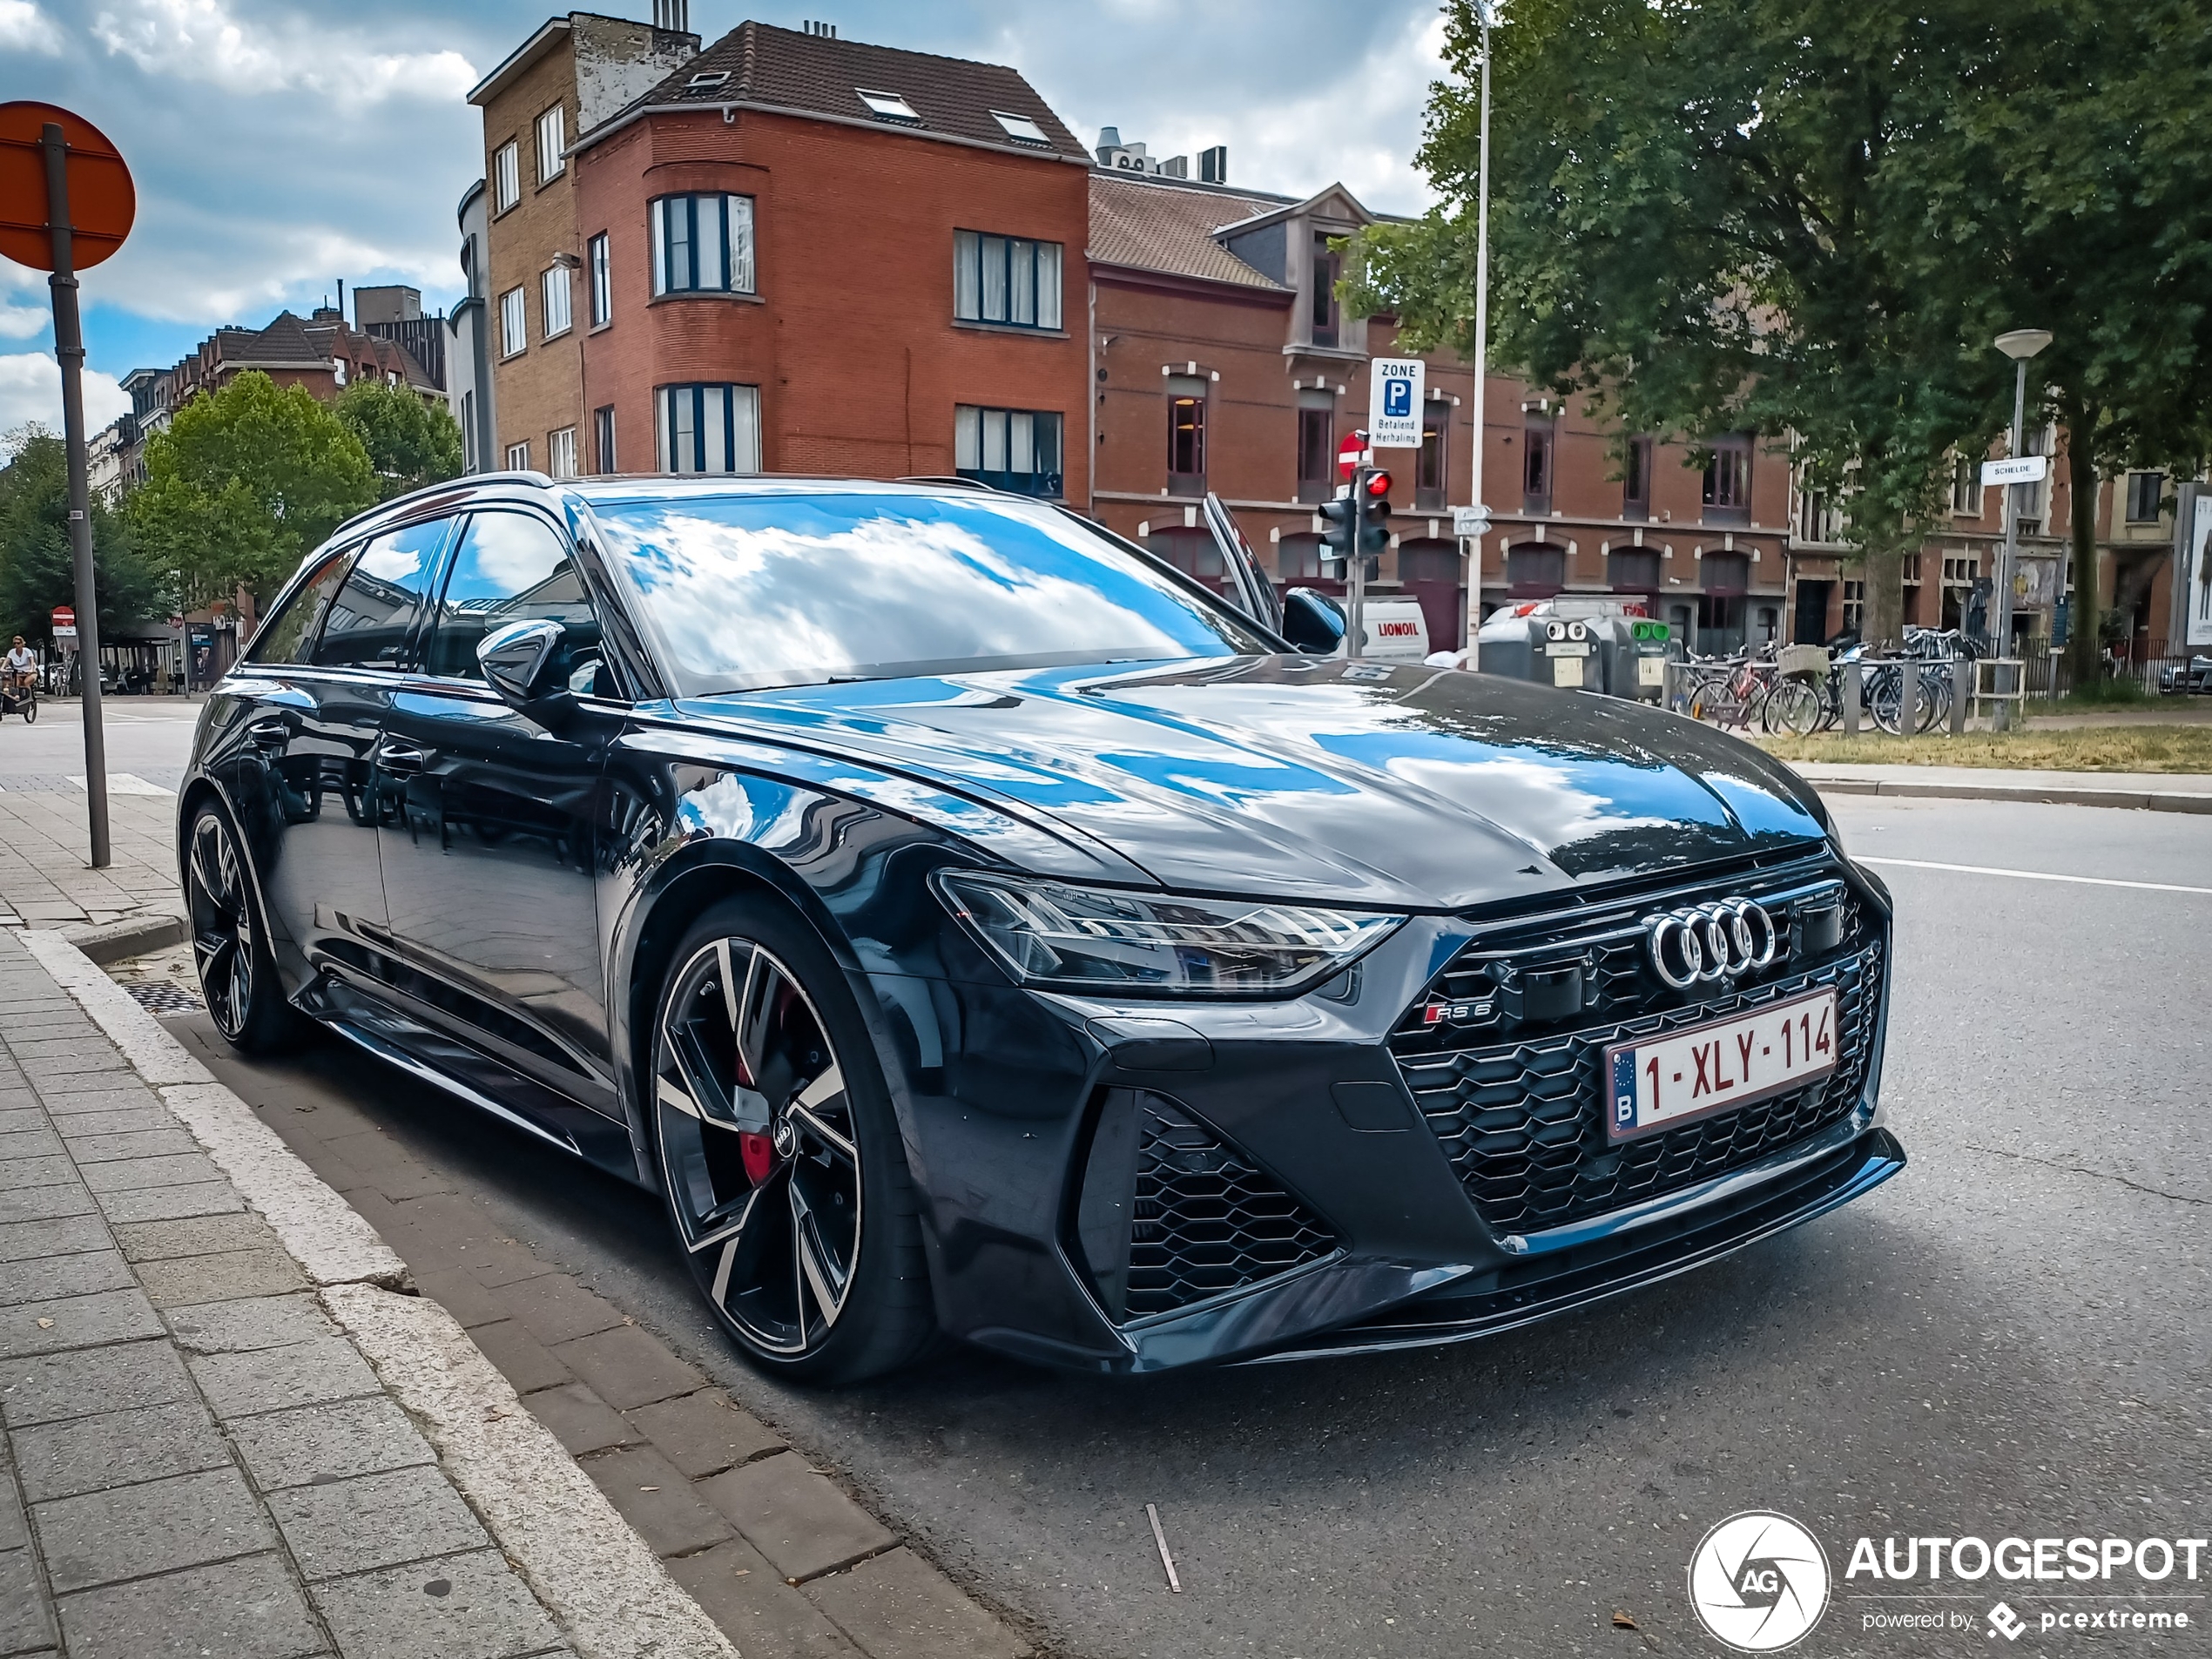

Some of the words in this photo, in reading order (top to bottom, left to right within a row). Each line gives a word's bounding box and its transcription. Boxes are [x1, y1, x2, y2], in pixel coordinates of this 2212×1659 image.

[1382, 364, 1416, 377] ZONE
[1390, 382, 1406, 407] P
[1379, 419, 1414, 429] Betalend
[1376, 433, 1415, 445] Herhaling
[1994, 465, 2030, 475] SCHELDE
[1378, 623, 1419, 636] LIONOIL
[1646, 1006, 1830, 1110] 1-XLY-114
[1617, 1095, 1632, 1122] B
